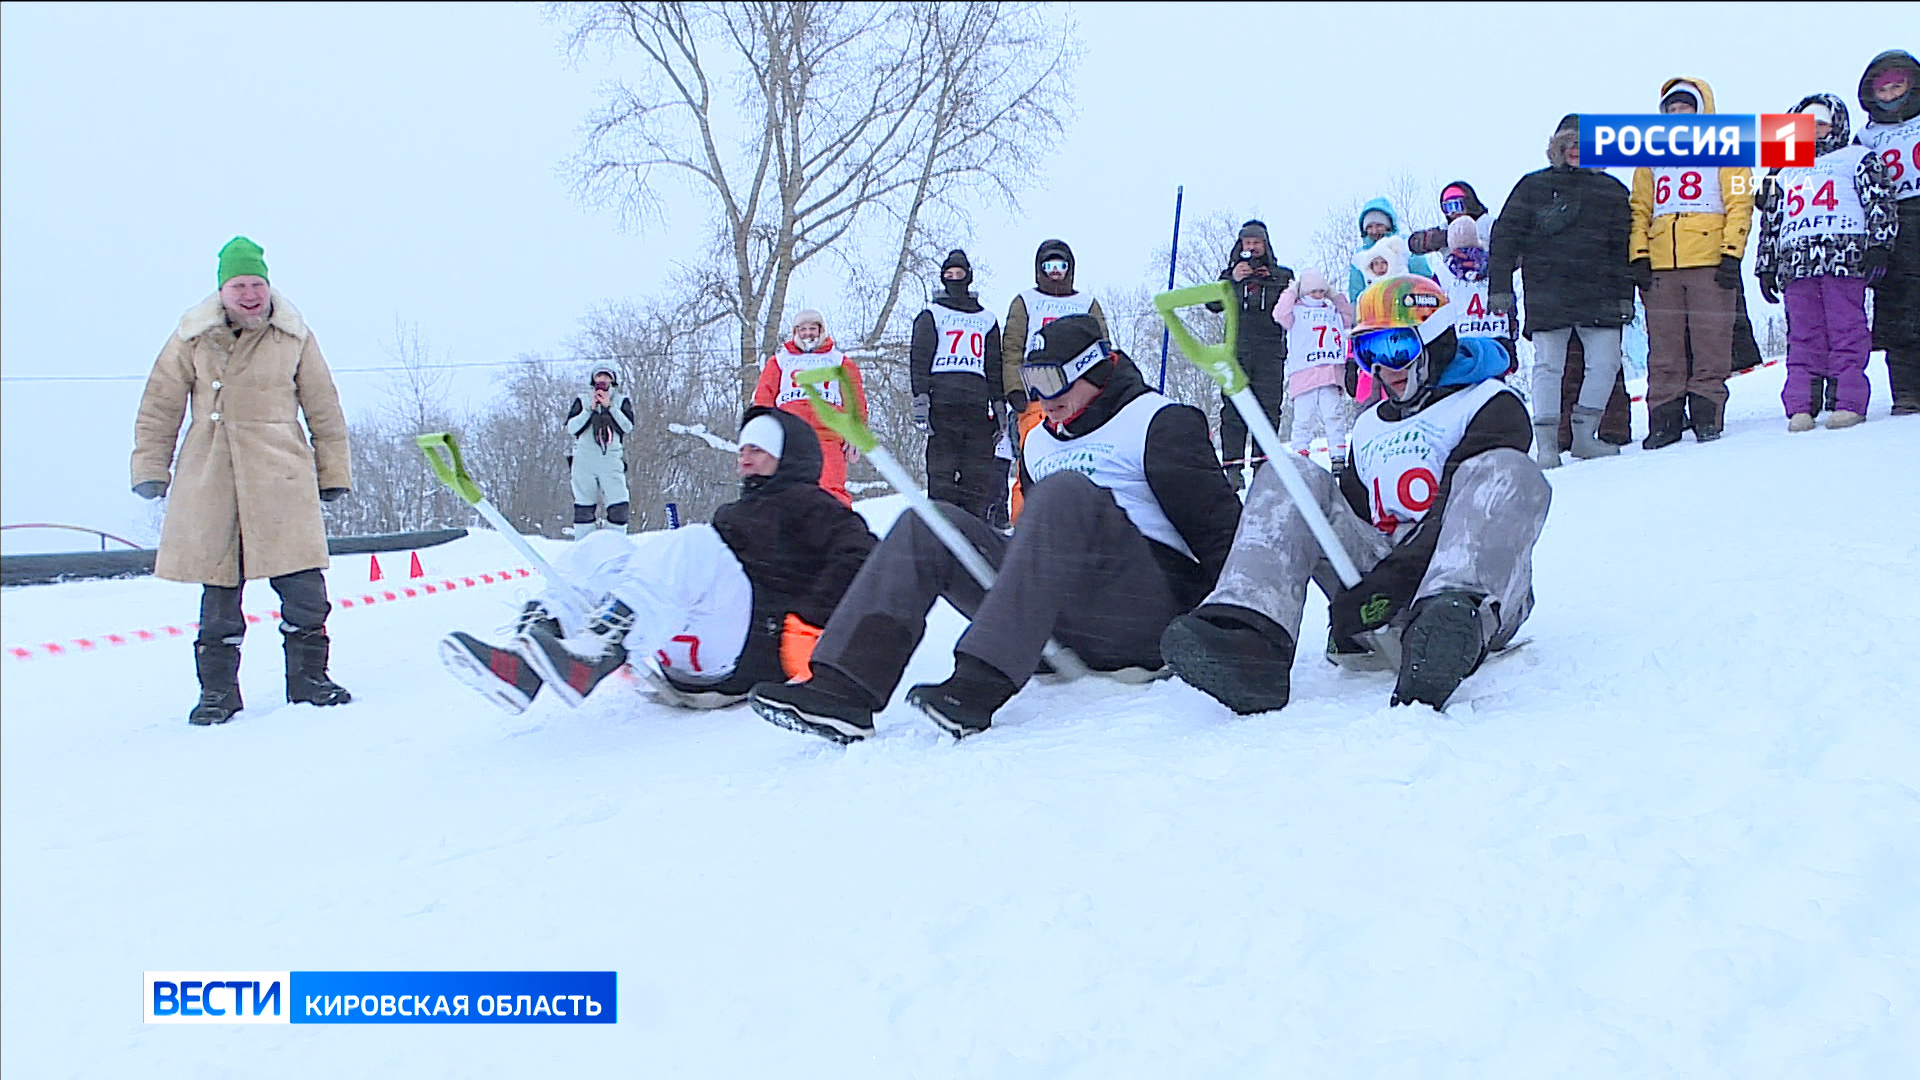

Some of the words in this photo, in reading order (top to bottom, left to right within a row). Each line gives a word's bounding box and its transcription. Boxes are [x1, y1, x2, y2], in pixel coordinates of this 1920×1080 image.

[1655, 171, 1703, 205] 68
[1786, 179, 1839, 217] 54
[1781, 215, 1838, 238] CRAFT
[1458, 321, 1506, 333] CRAFT
[945, 329, 983, 358] 70
[935, 355, 983, 367] CRAFT
